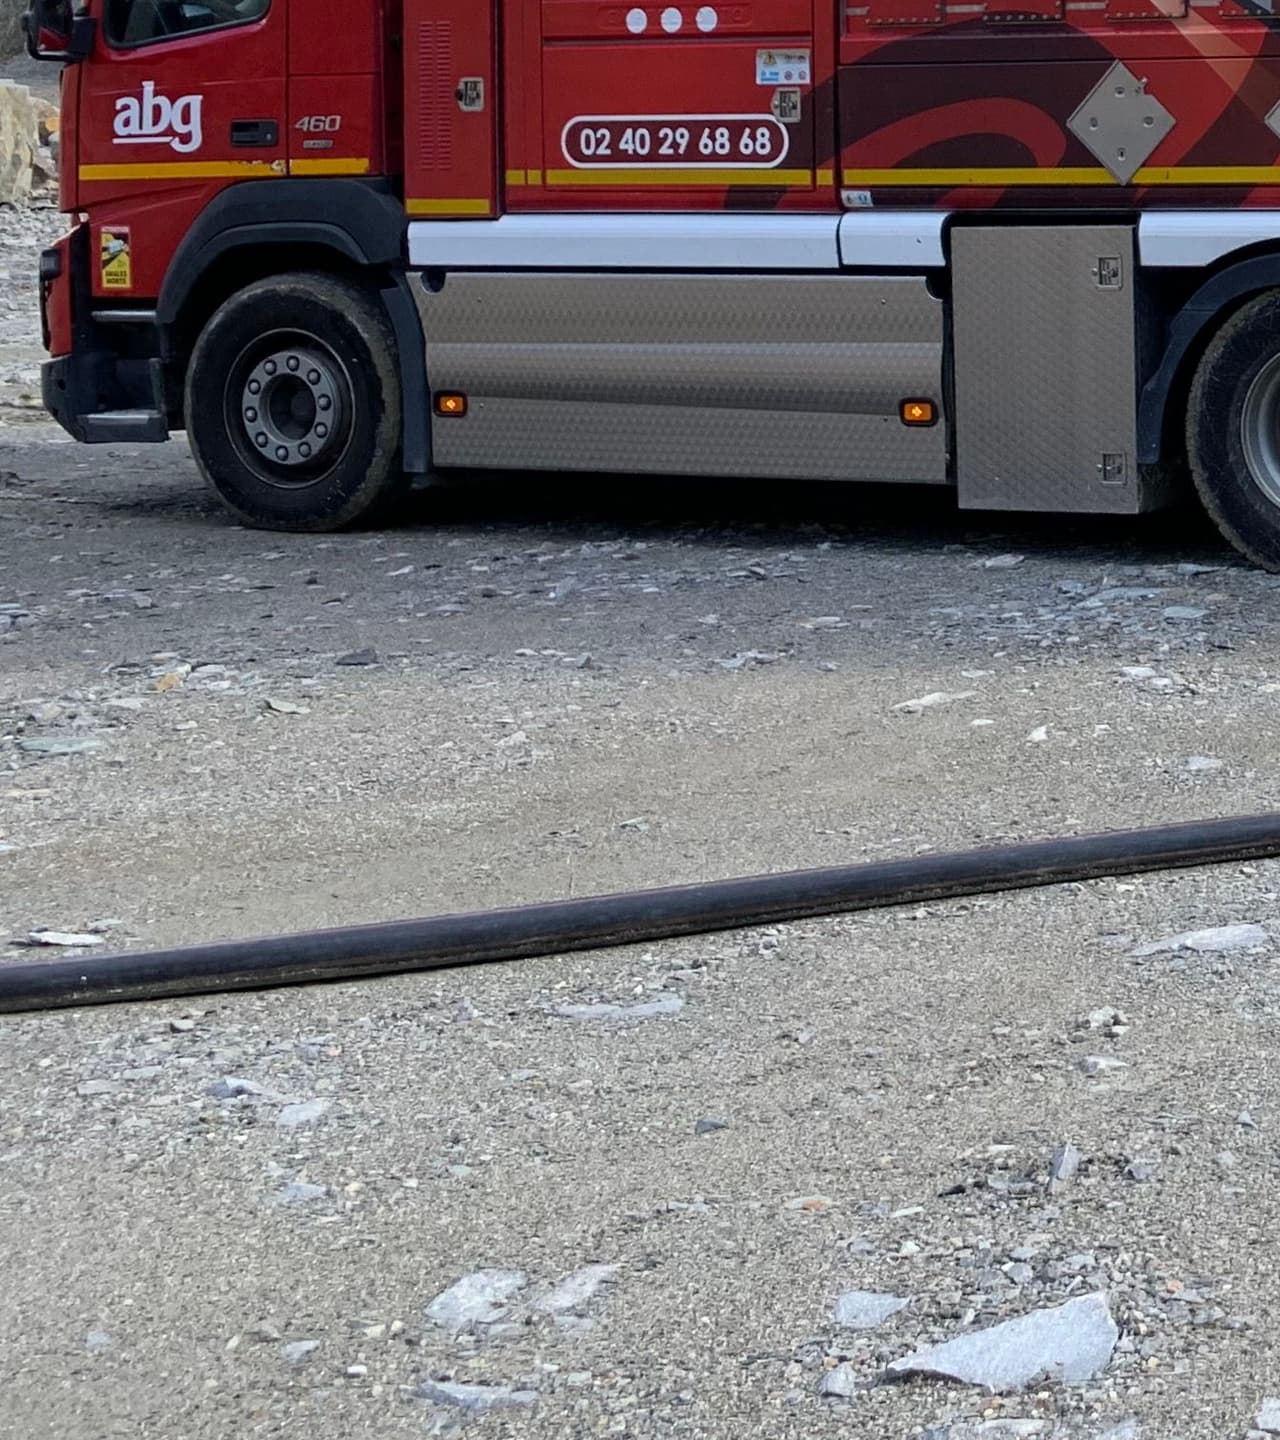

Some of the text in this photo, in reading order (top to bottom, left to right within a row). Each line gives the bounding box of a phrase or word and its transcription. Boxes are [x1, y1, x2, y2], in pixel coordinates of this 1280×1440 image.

[112, 80, 204, 153] abg
[294, 115, 341, 133] 460
[579, 127, 772, 156] 02 40 29 68 68
